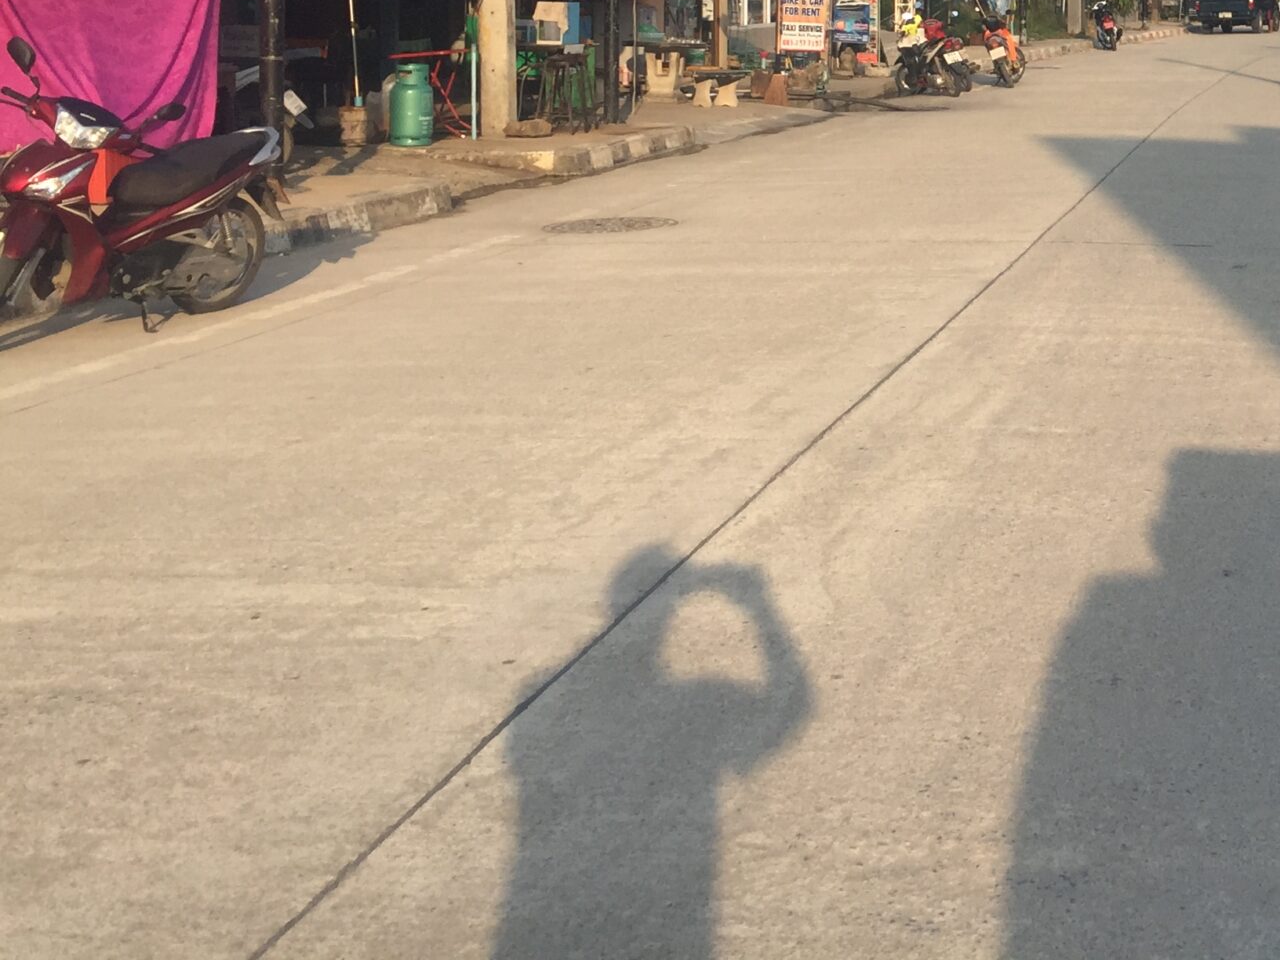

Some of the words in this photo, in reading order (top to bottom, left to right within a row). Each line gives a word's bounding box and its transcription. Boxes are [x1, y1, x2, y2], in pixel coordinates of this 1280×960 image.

[784, 6, 799, 16] FOR
[801, 7, 821, 17] RENT
[782, 23, 797, 32] TAXI
[798, 25, 824, 33] SERVICE
